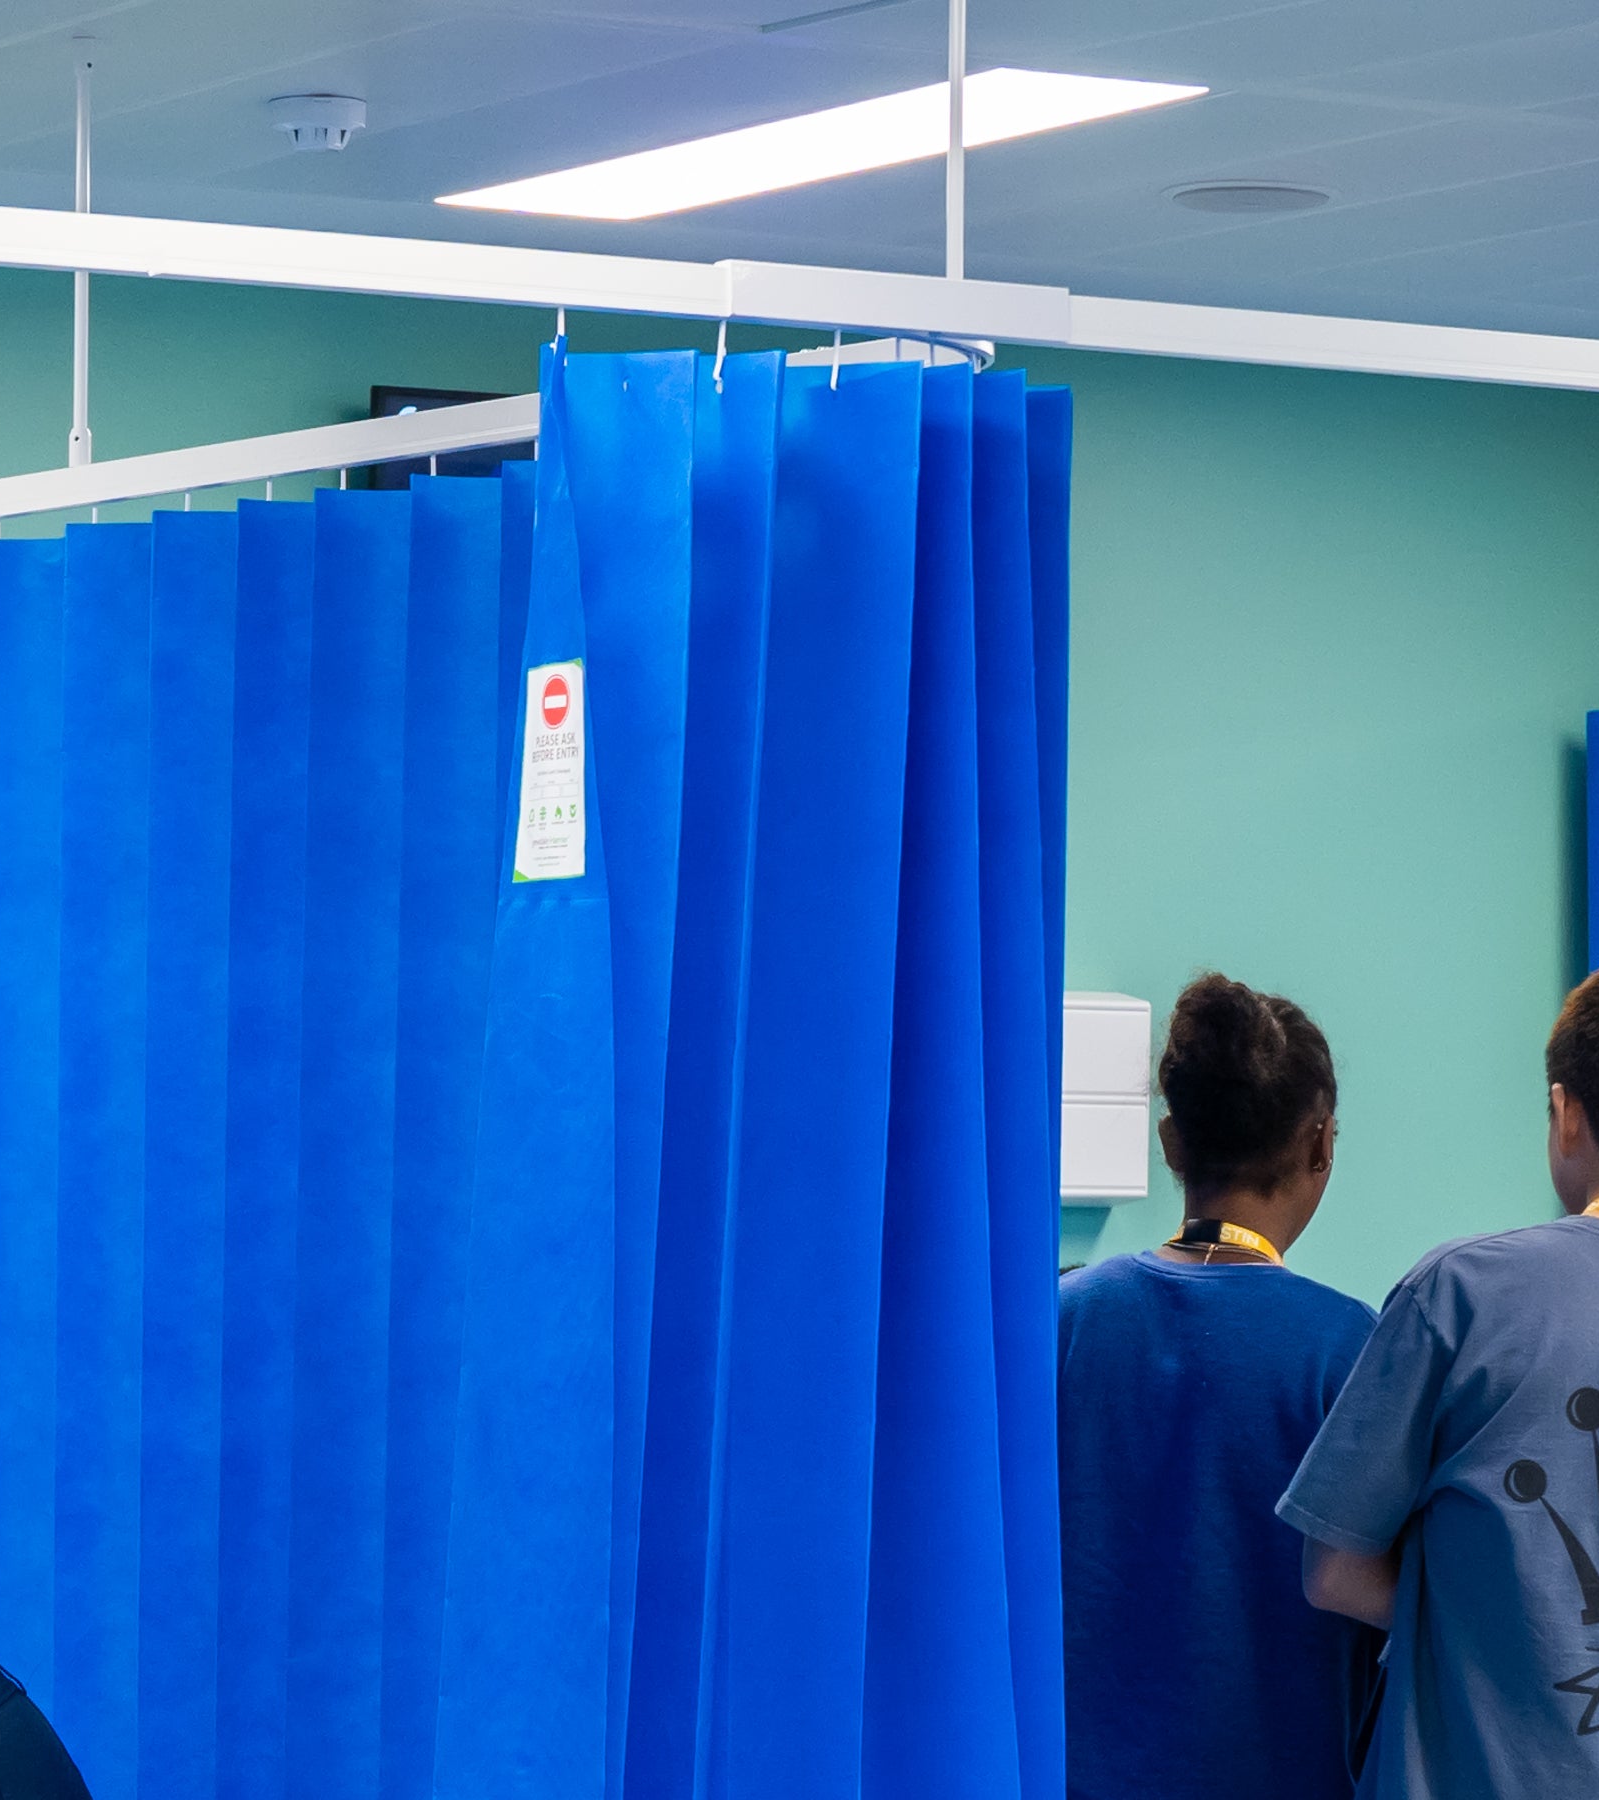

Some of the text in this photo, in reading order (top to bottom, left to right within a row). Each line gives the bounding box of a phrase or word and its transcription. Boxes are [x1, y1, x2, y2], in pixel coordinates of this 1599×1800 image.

[535, 732, 576, 748] PLEASE ASK
[532, 746, 579, 763] BEFORE ENTRY
